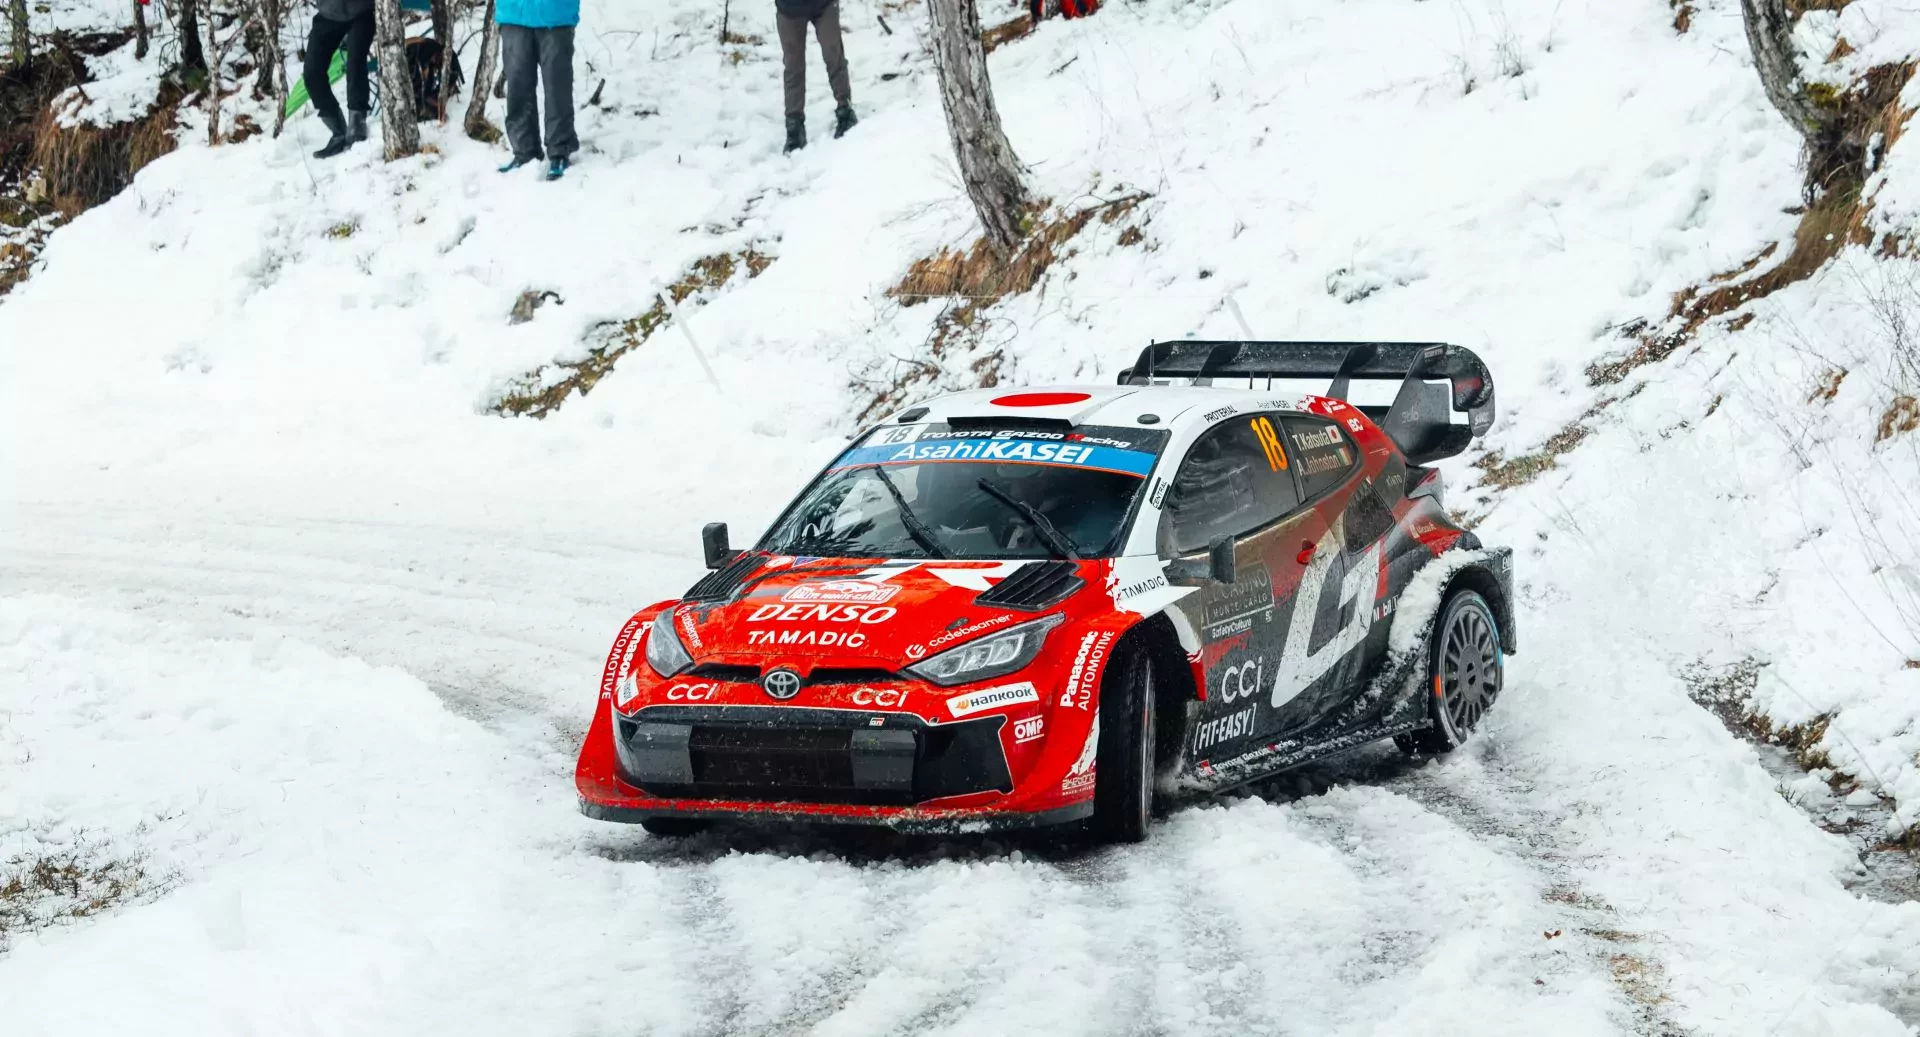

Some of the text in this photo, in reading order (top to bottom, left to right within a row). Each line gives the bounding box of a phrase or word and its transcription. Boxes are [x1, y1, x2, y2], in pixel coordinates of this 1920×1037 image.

[1204, 405, 1238, 423] PROTERIAL
[884, 426, 914, 443] 18
[923, 430, 1132, 448] TOYOTA GAZOO Racing
[1251, 415, 1289, 473] 18
[1292, 430, 1330, 451] T.Katsuta
[890, 440, 1094, 464] AsahiKASEI
[1152, 480, 1168, 509] CENTRAL
[1122, 575, 1165, 599] TAMADIC
[746, 603, 898, 624] DENSO
[749, 630, 866, 648] TAMADIC
[929, 614, 1011, 647] codebeamer
[1211, 617, 1252, 639] SafetyCulture
[601, 620, 639, 700] AUTOMOTIVE
[1060, 630, 1099, 708] Panasonic
[1078, 630, 1115, 712] AUTOMOTIVE
[1014, 718, 1044, 740] OMP
